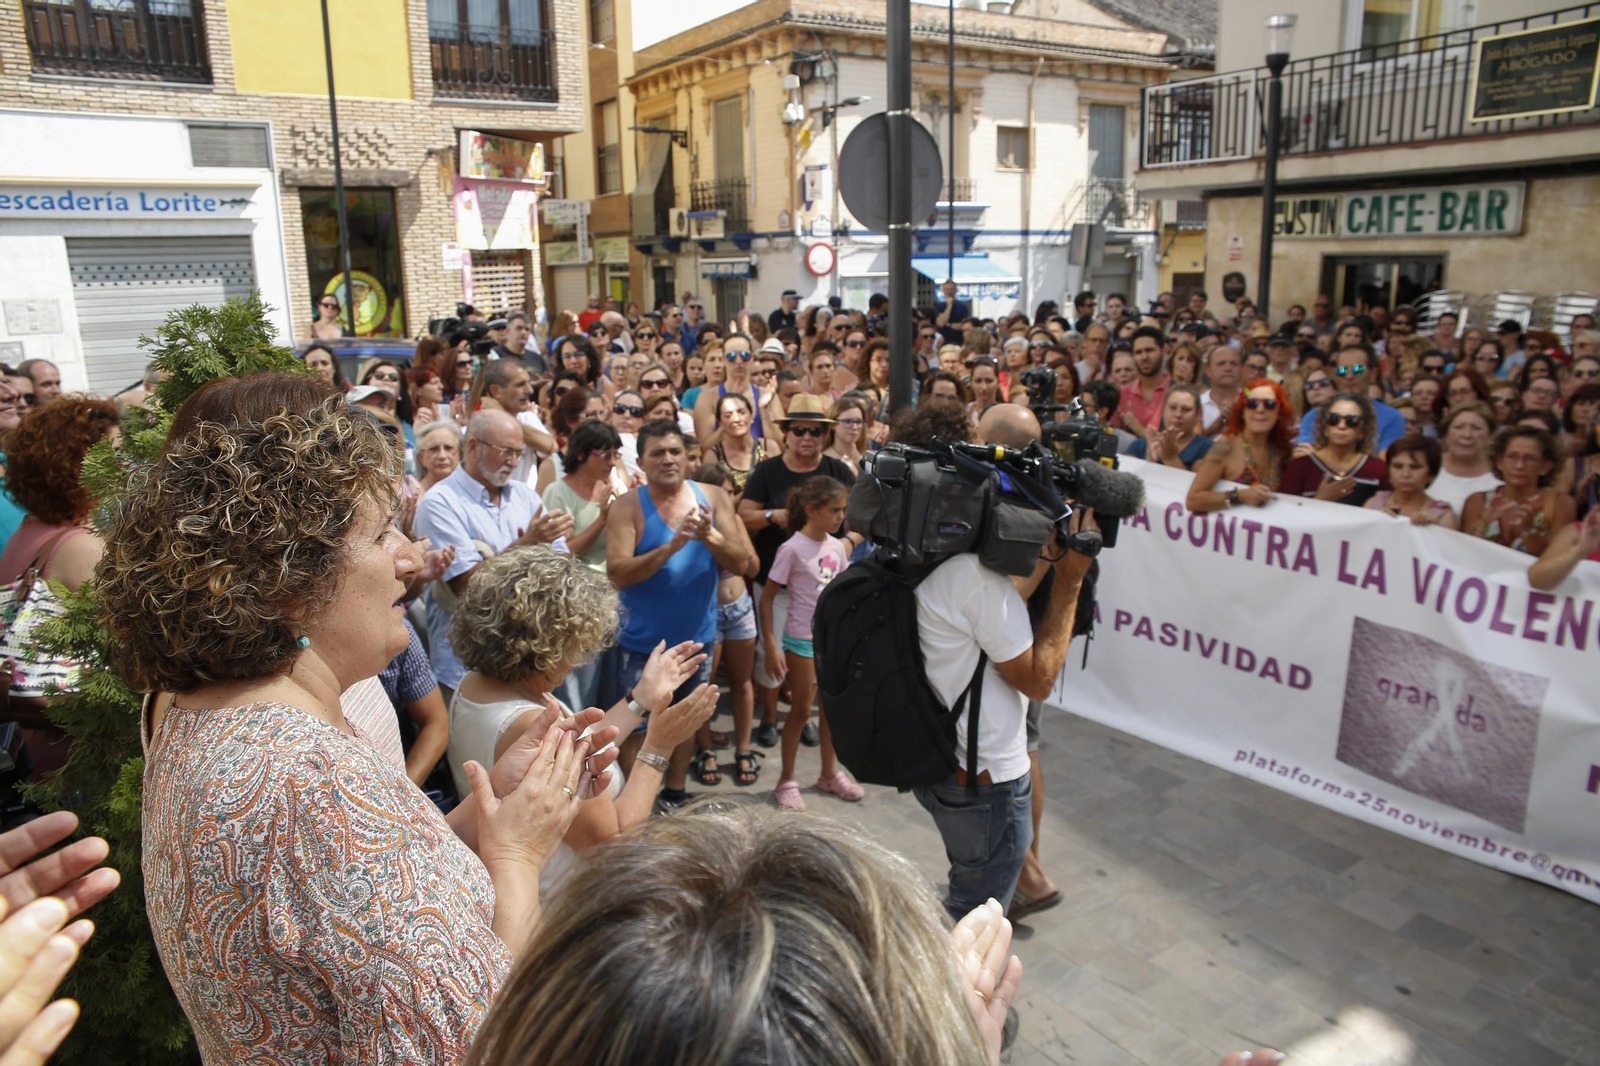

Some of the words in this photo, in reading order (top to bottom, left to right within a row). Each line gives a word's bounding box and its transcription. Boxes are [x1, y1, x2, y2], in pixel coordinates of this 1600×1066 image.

[1498, 50, 1577, 72] ABOGADO
[140, 191, 217, 212] Lorite
[1347, 189, 1510, 234] CAFE-BAR
[1165, 502, 1319, 577] CONTRA
[1337, 541, 1387, 595] LA
[1412, 556, 1600, 651] VIOLEN
[1114, 609, 1313, 691] PASIVIDAD
